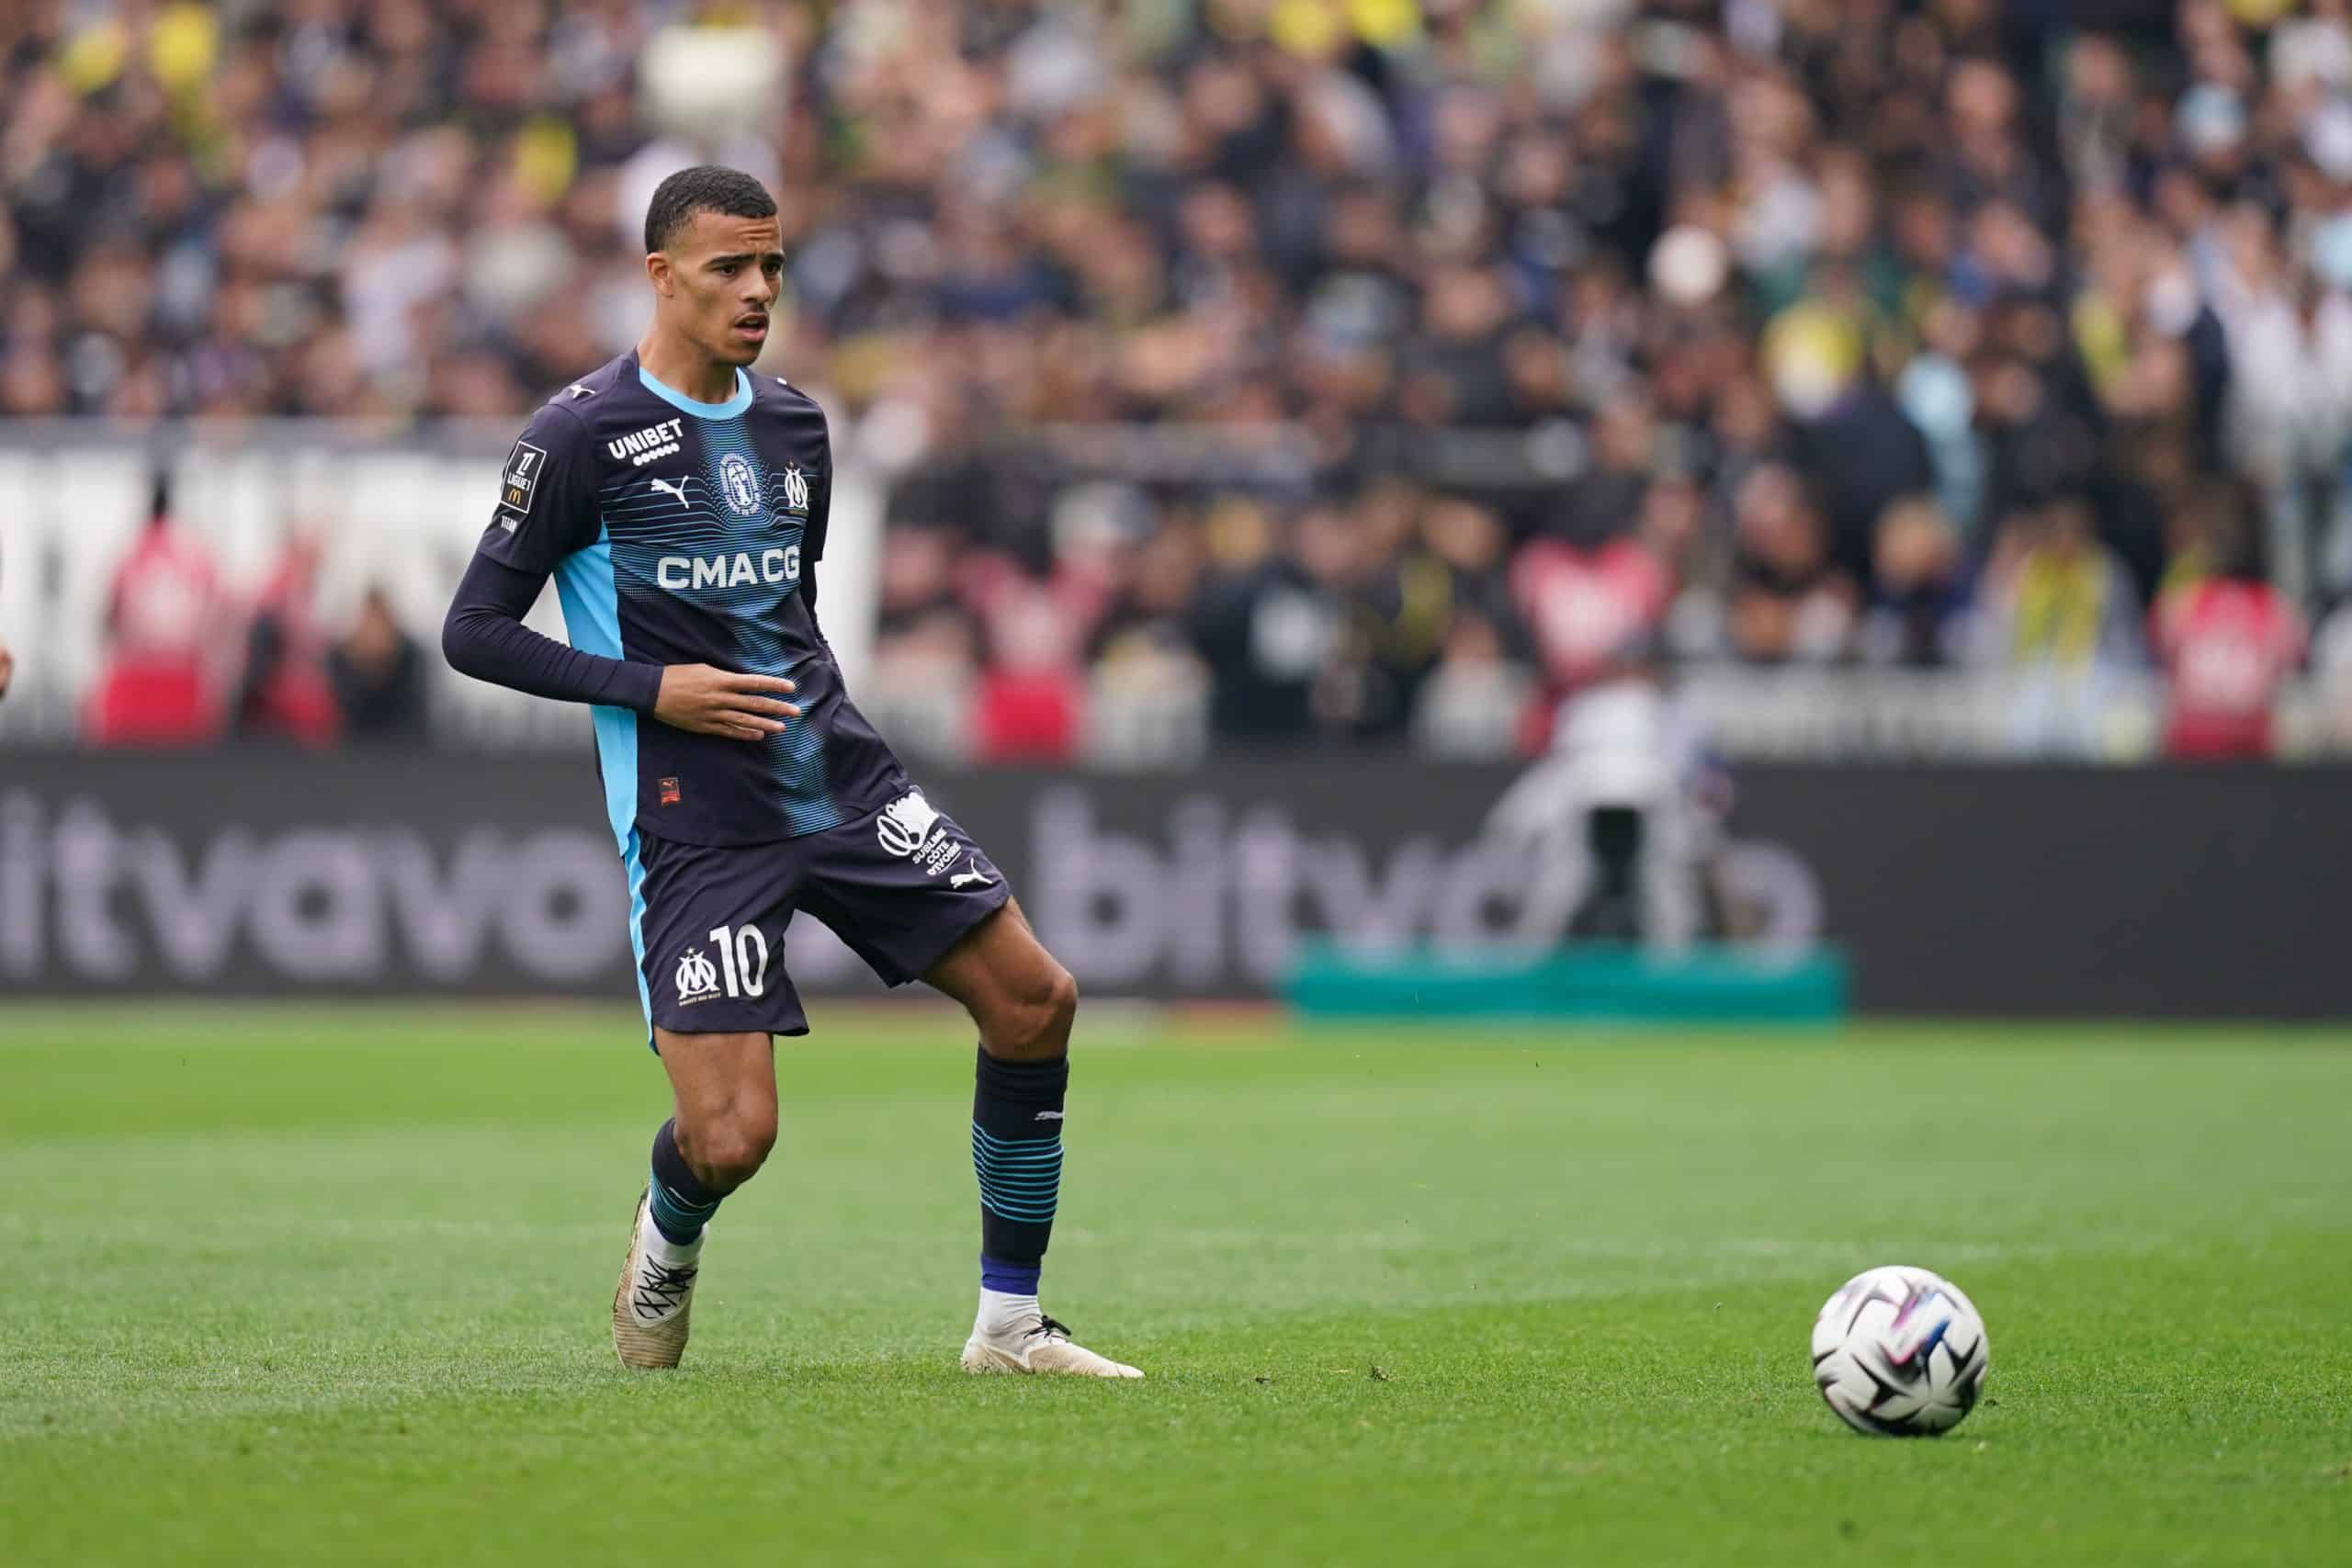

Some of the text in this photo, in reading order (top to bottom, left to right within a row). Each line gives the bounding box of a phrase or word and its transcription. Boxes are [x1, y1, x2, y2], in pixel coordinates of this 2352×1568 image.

[608, 418, 684, 459] UNIBET
[657, 553, 758, 590] CMA
[912, 826, 947, 864] SUBLIME
[1029, 785, 1826, 987] bitvao
[709, 924, 768, 998] 10
